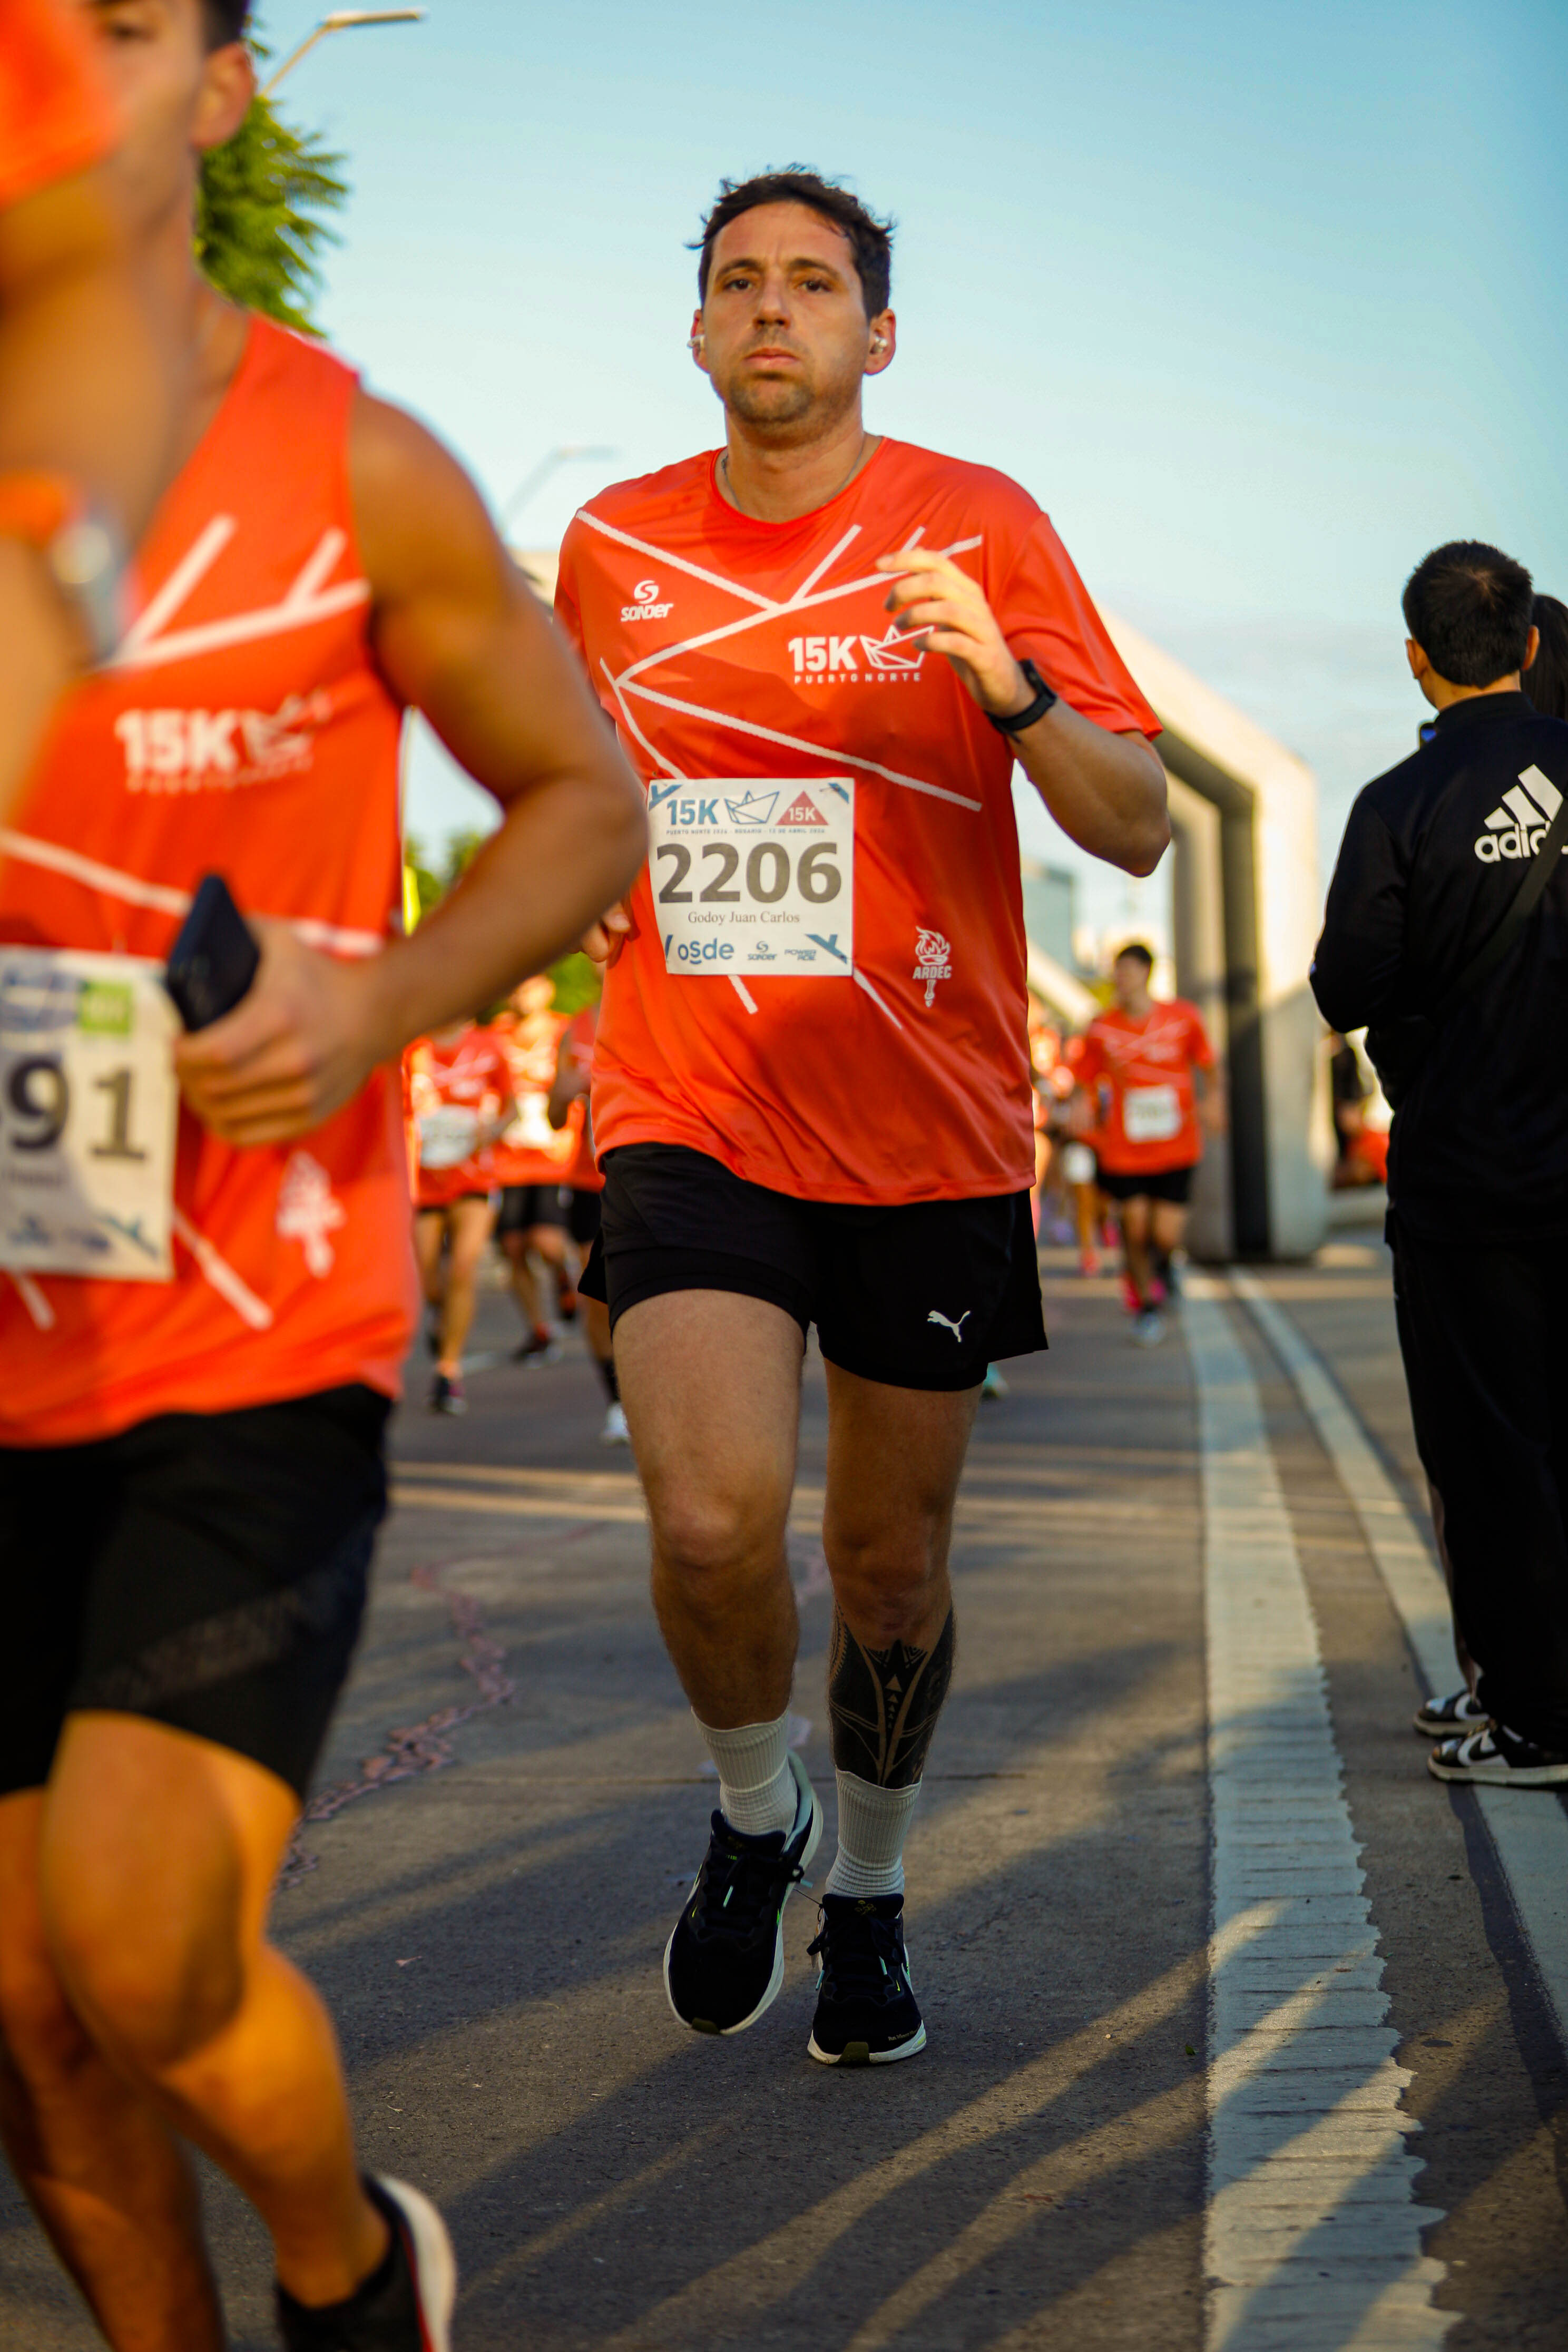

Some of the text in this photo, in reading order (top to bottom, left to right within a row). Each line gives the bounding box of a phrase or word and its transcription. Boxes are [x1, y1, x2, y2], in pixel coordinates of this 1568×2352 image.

[788, 636, 858, 672] 15K
[794, 672, 921, 684] PUERTO NORTE
[114, 709, 240, 772] 15K
[667, 799, 720, 826] 15K
[789, 807, 817, 821] 15K
[656, 842, 842, 904] 2206
[688, 910, 800, 926] Godoy Juan Carlos
[678, 937, 734, 964] osde
[913, 965, 952, 979] ARDEC
[0, 1054, 144, 1162] 91
